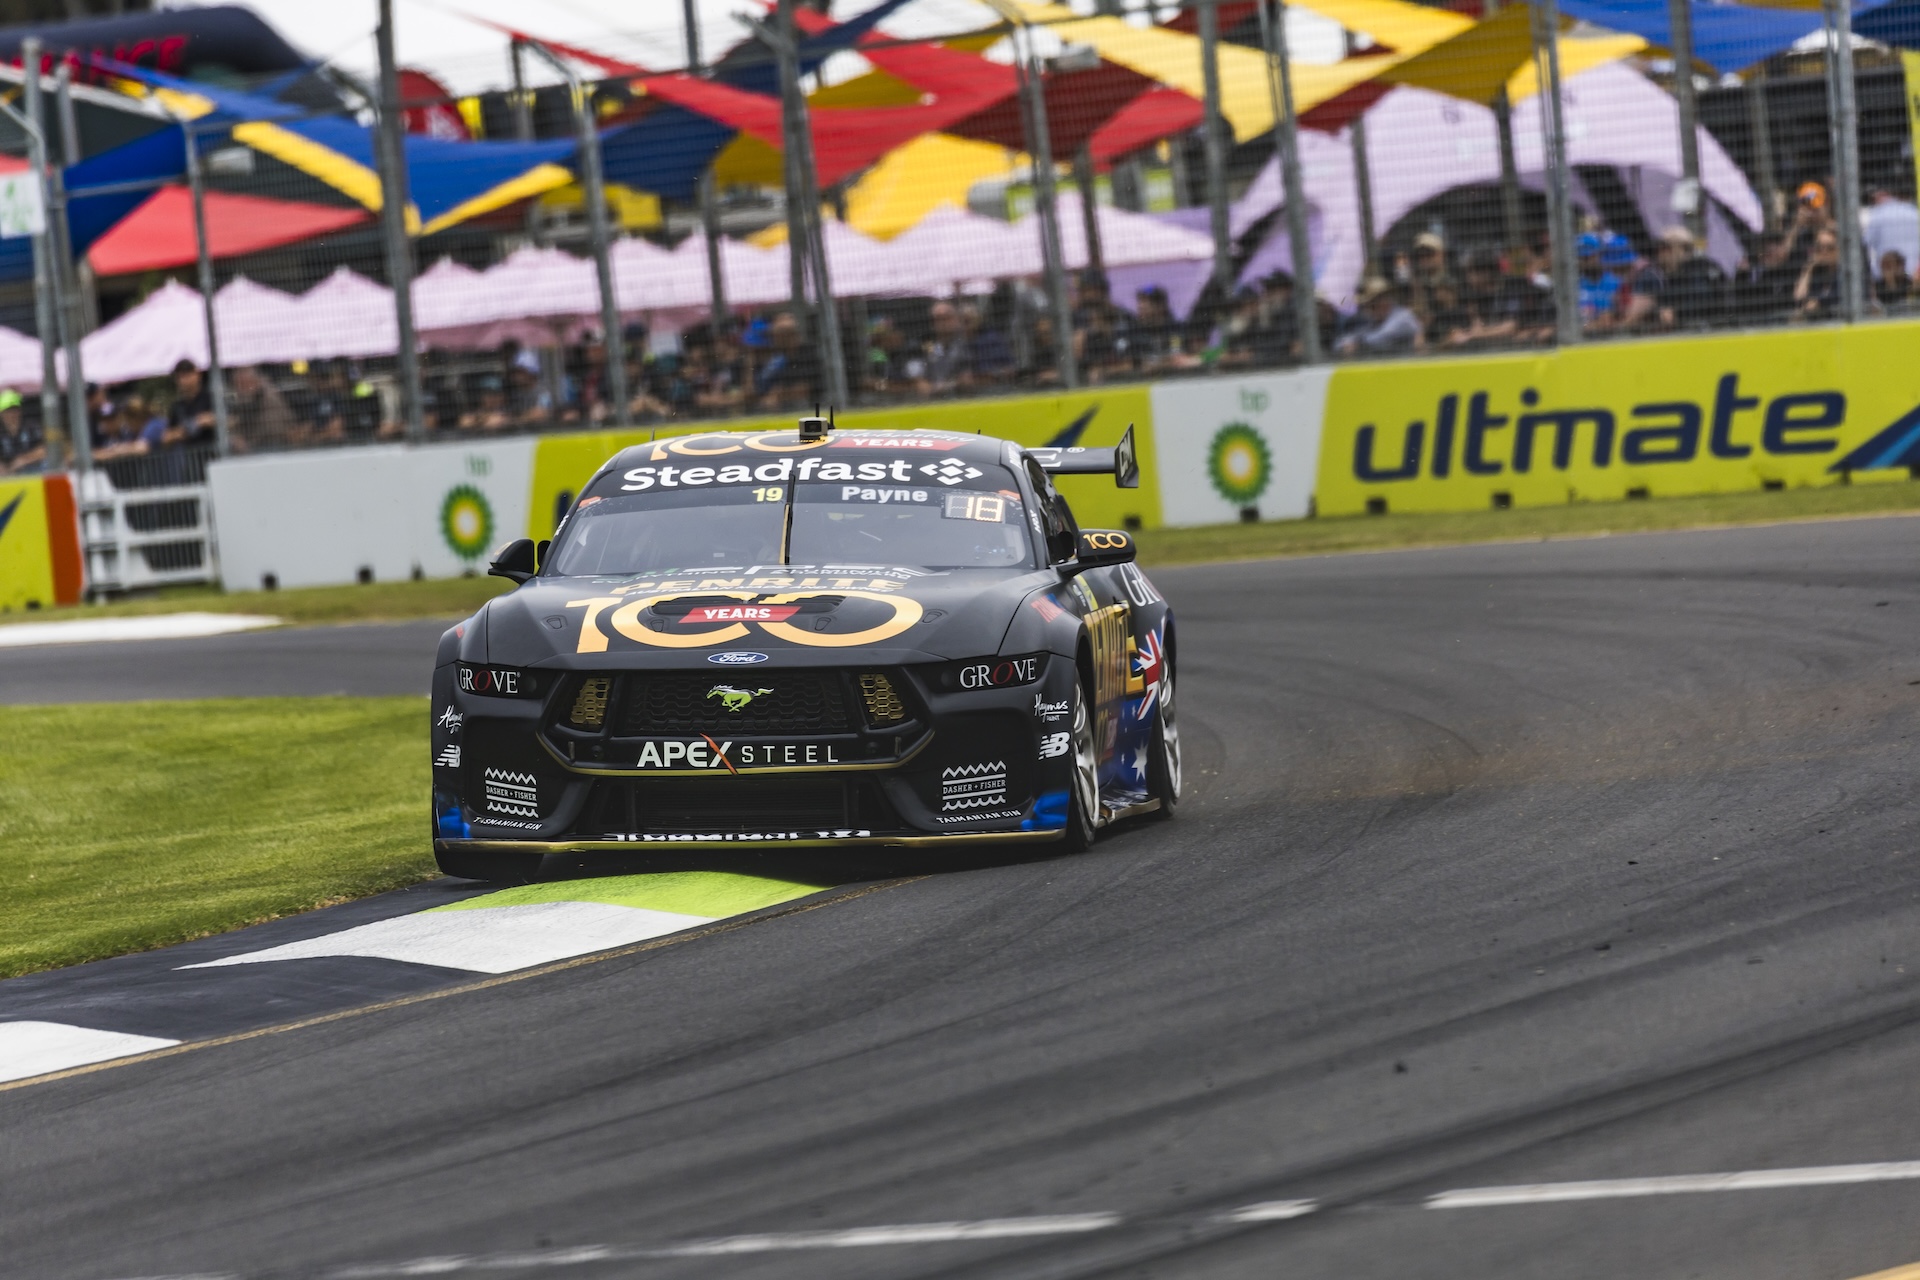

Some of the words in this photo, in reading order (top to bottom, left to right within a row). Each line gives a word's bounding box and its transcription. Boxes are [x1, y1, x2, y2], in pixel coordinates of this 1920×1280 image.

[1353, 373, 1846, 482] ultimate
[852, 438, 934, 448] YEARS
[620, 457, 912, 491] Steadfast
[752, 488, 783, 502] 19
[842, 486, 928, 503] Payne
[609, 577, 907, 595] PENRITE
[704, 608, 771, 619] YEARS
[717, 652, 758, 663] Ford
[637, 741, 737, 775] APEX
[741, 745, 839, 763] STEEL
[486, 786, 508, 797] DASHER
[514, 790, 537, 801] FISHER
[943, 783, 973, 795] DASHER
[980, 779, 1006, 790] FISHER
[936, 812, 1000, 824] TASMANIAN
[1002, 810, 1021, 818] GIN
[524, 822, 542, 830] GIN
